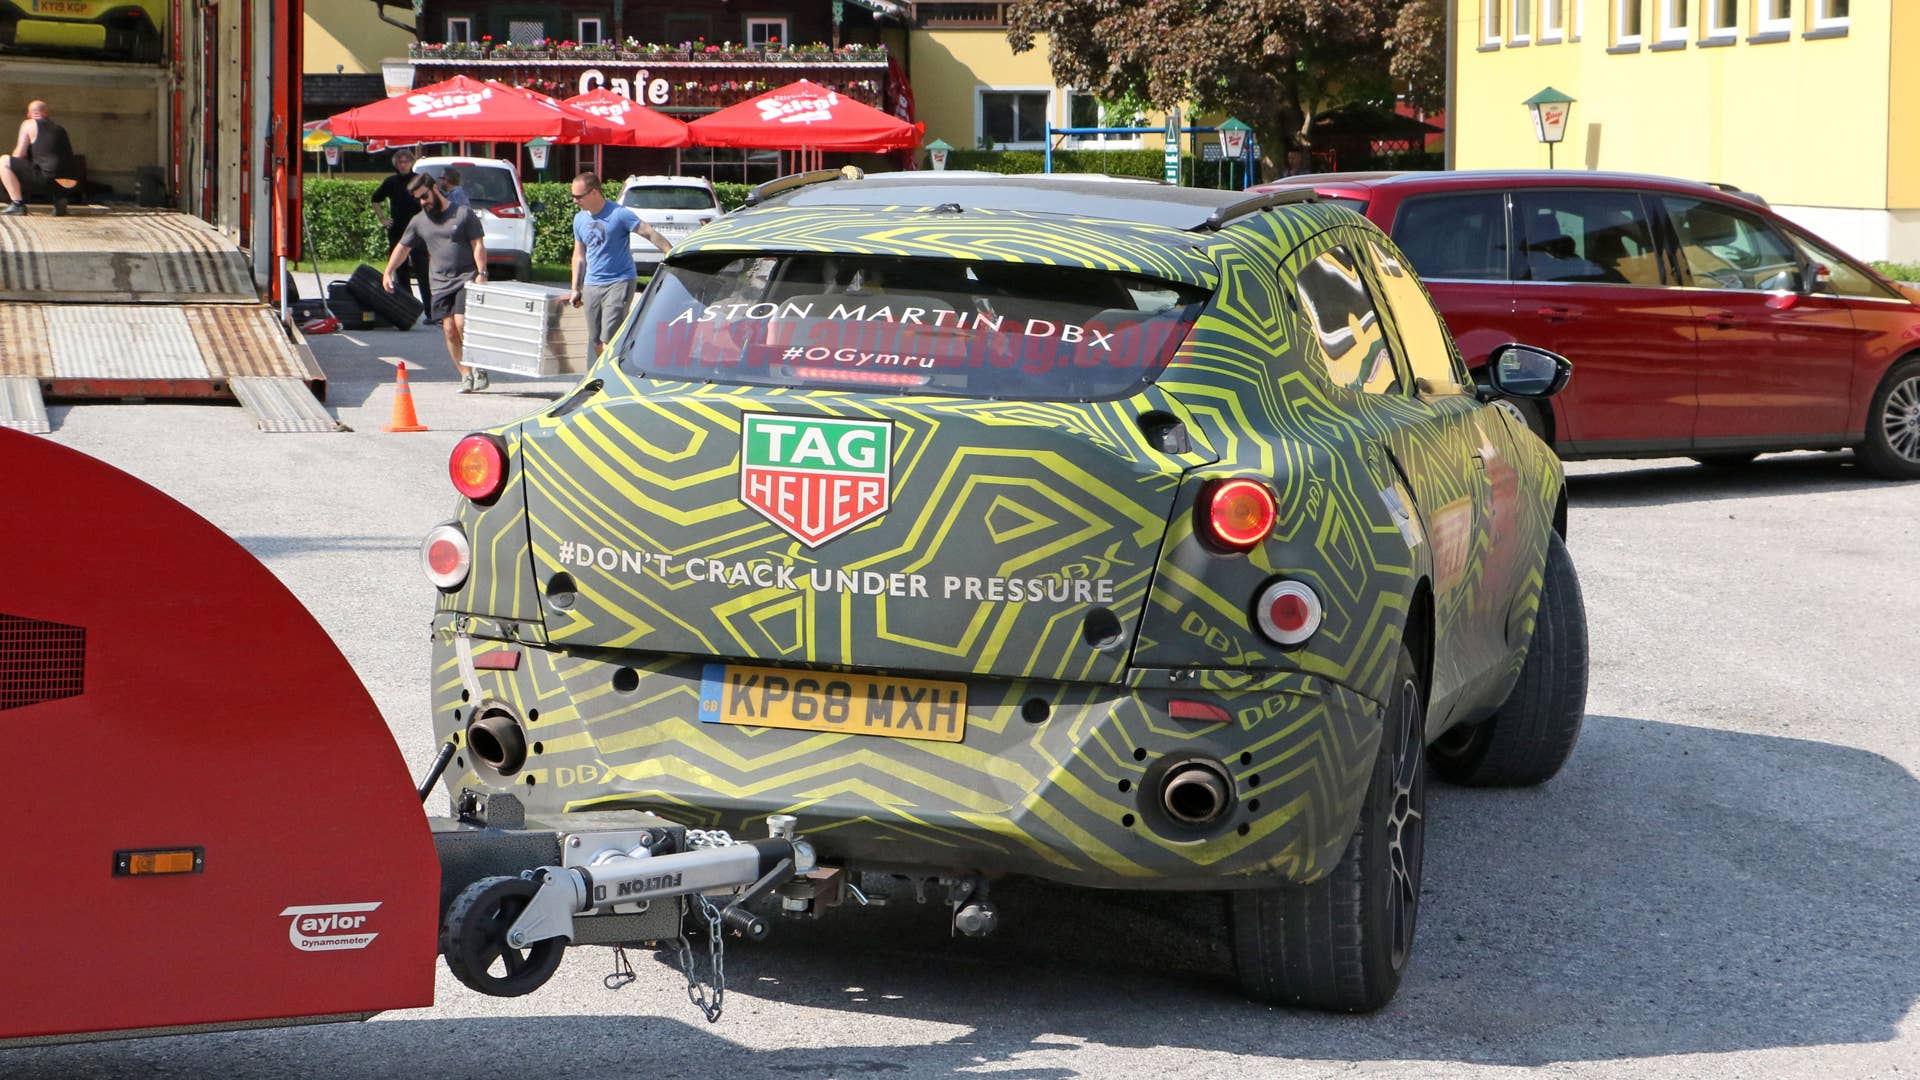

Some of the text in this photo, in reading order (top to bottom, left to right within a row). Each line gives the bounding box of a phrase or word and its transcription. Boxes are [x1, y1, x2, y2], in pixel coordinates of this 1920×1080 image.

[406, 87, 492, 115] Stiegl
[578, 68, 669, 106] Cafe
[755, 91, 839, 121] Stiegl
[668, 303, 1115, 351] ASTON MARTIN DBX
[782, 346, 936, 369] #OGymru
[756, 423, 876, 468] TAG
[750, 473, 880, 537] HEUER
[685, 558, 798, 590] CRACK
[811, 568, 929, 598] UNDER
[944, 575, 1114, 603] PRESSURE
[703, 699, 719, 712] GB
[729, 672, 959, 734] KP68 MXH
[617, 873, 682, 897] FULTON
[301, 936, 369, 948] Dynamometer
